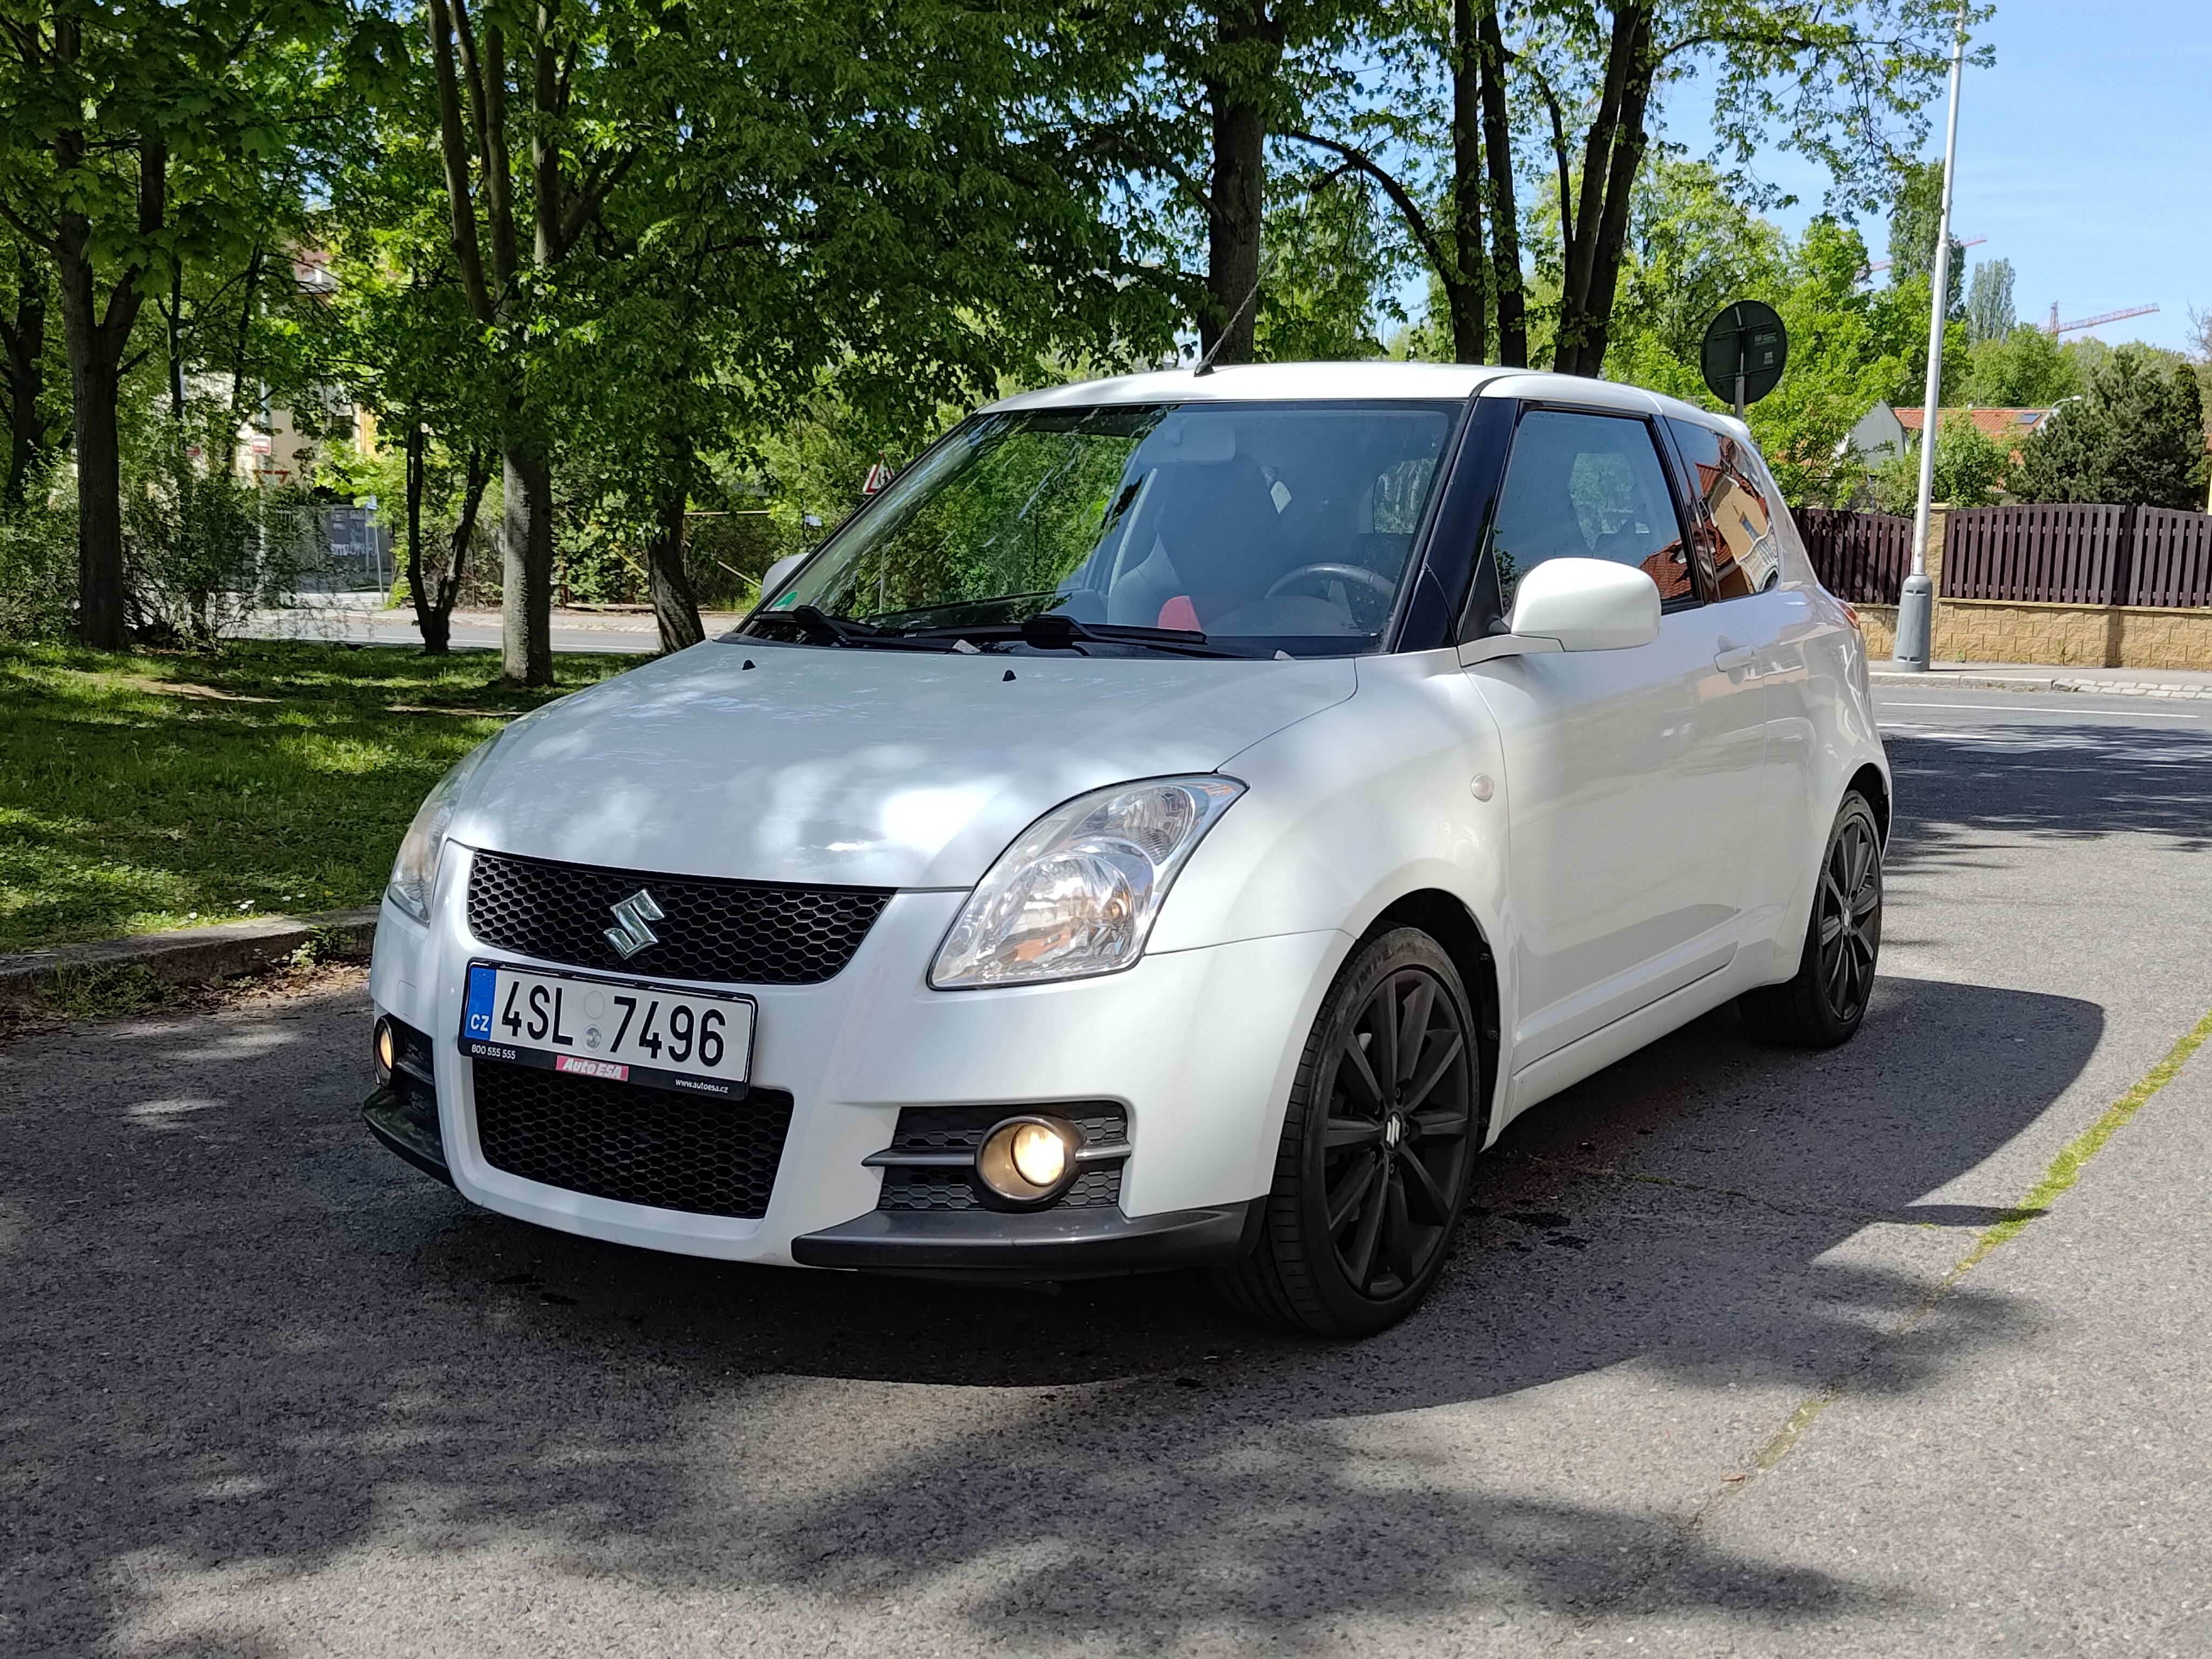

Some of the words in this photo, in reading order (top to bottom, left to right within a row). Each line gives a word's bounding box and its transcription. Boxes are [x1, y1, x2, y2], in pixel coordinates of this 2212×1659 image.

[470, 1014, 489, 1031] CZ
[501, 981, 574, 1046] 4SL
[609, 995, 726, 1067] 7496
[471, 1044, 486, 1055] 800
[487, 1047, 501, 1057] 555
[502, 1049, 516, 1060] 555
